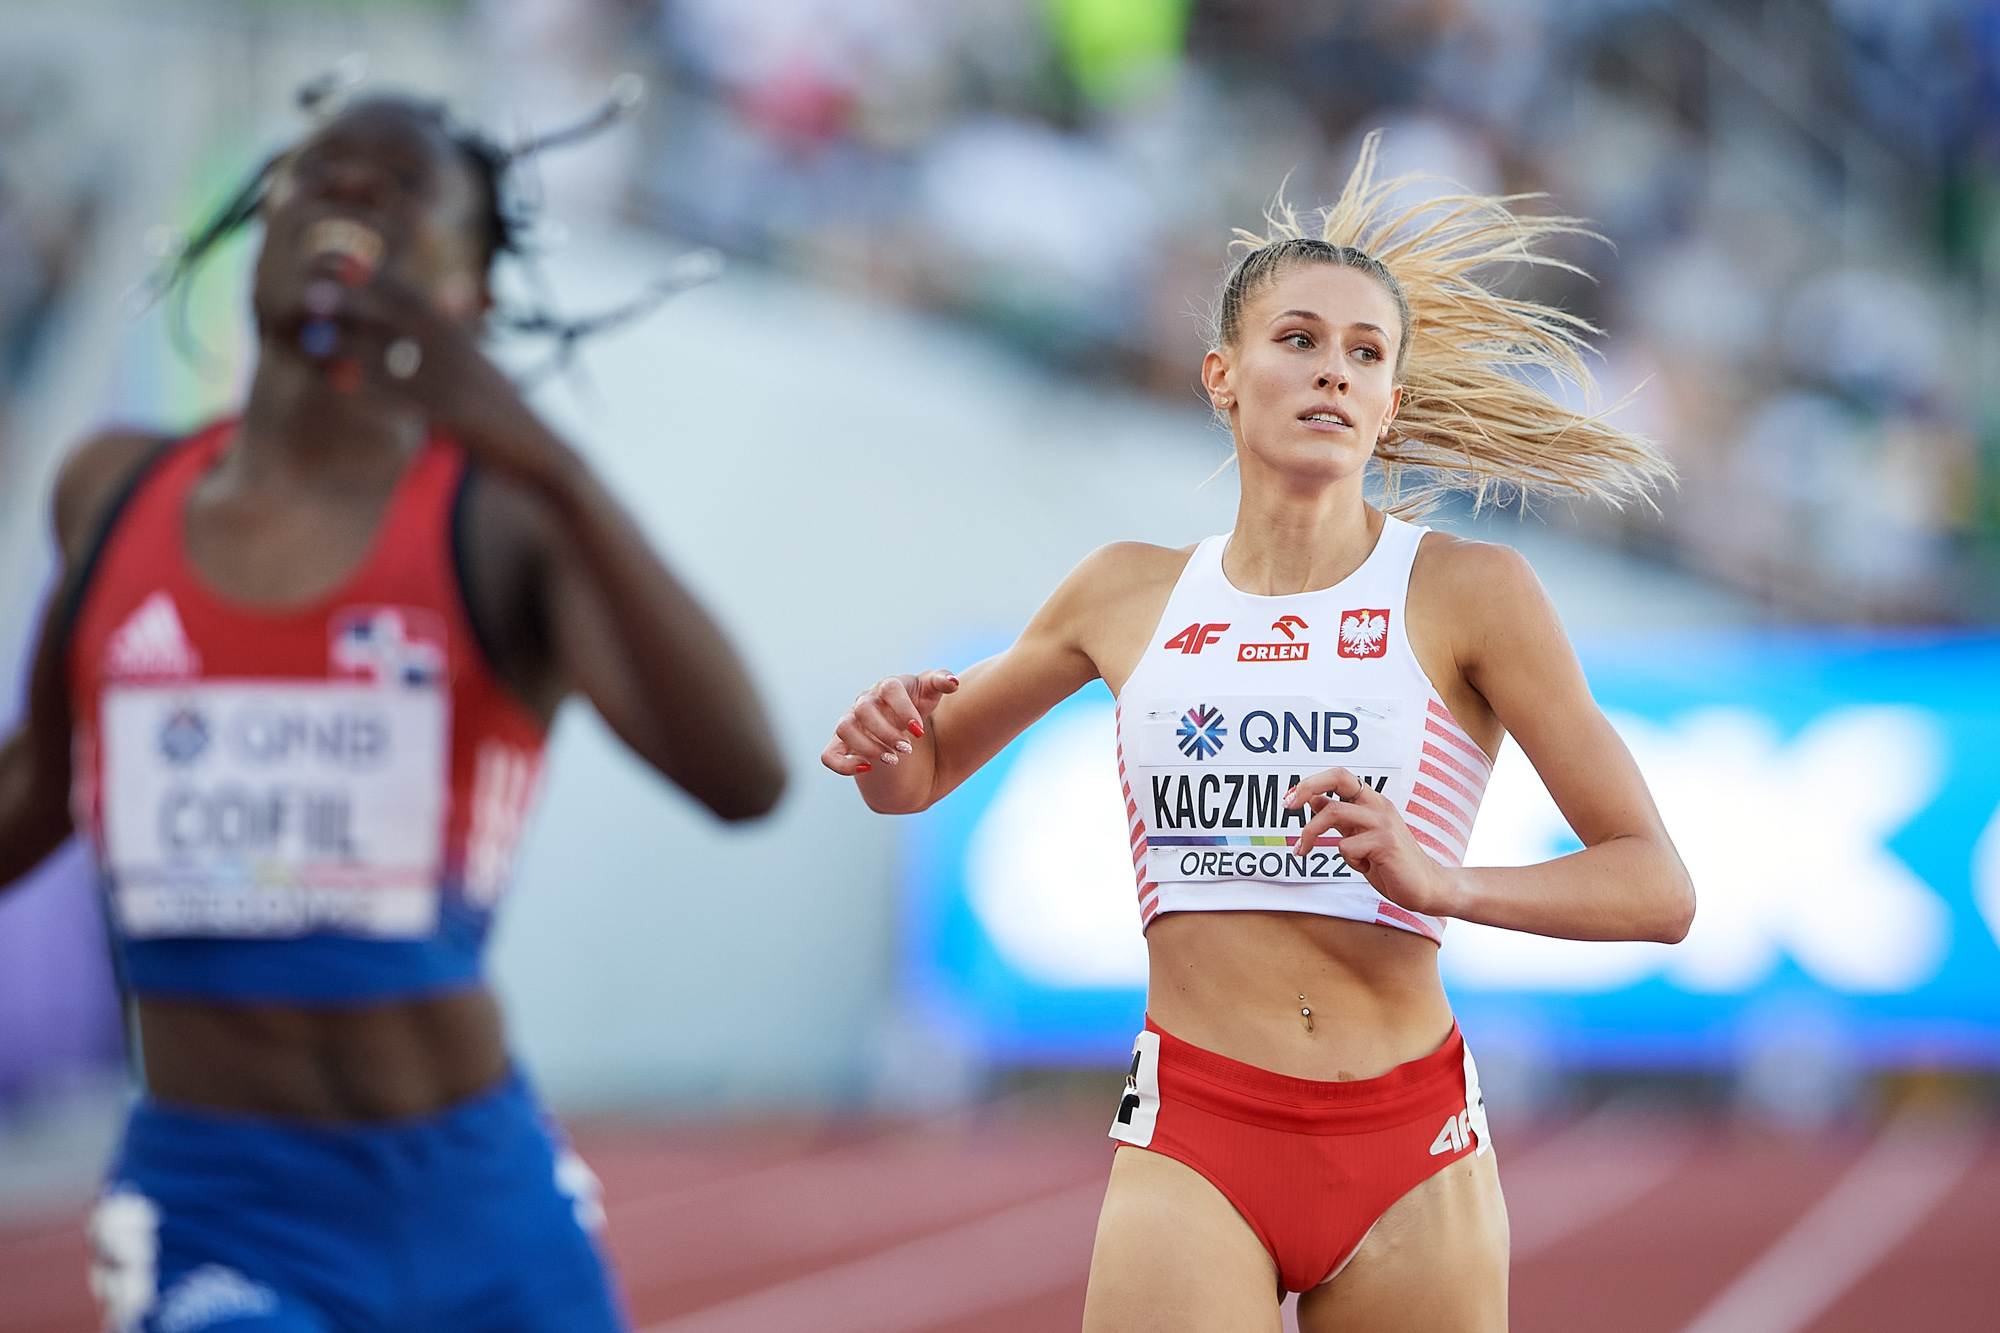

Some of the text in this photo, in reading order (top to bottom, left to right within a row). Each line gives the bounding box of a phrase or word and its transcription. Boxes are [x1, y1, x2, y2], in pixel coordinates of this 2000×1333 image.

[1164, 623, 1231, 655] 4F
[1241, 645, 1305, 661] ORLEN
[1239, 710, 1360, 754] QNB
[1151, 774, 1389, 829] KACZMA
[1180, 851, 1352, 878] OREGON22
